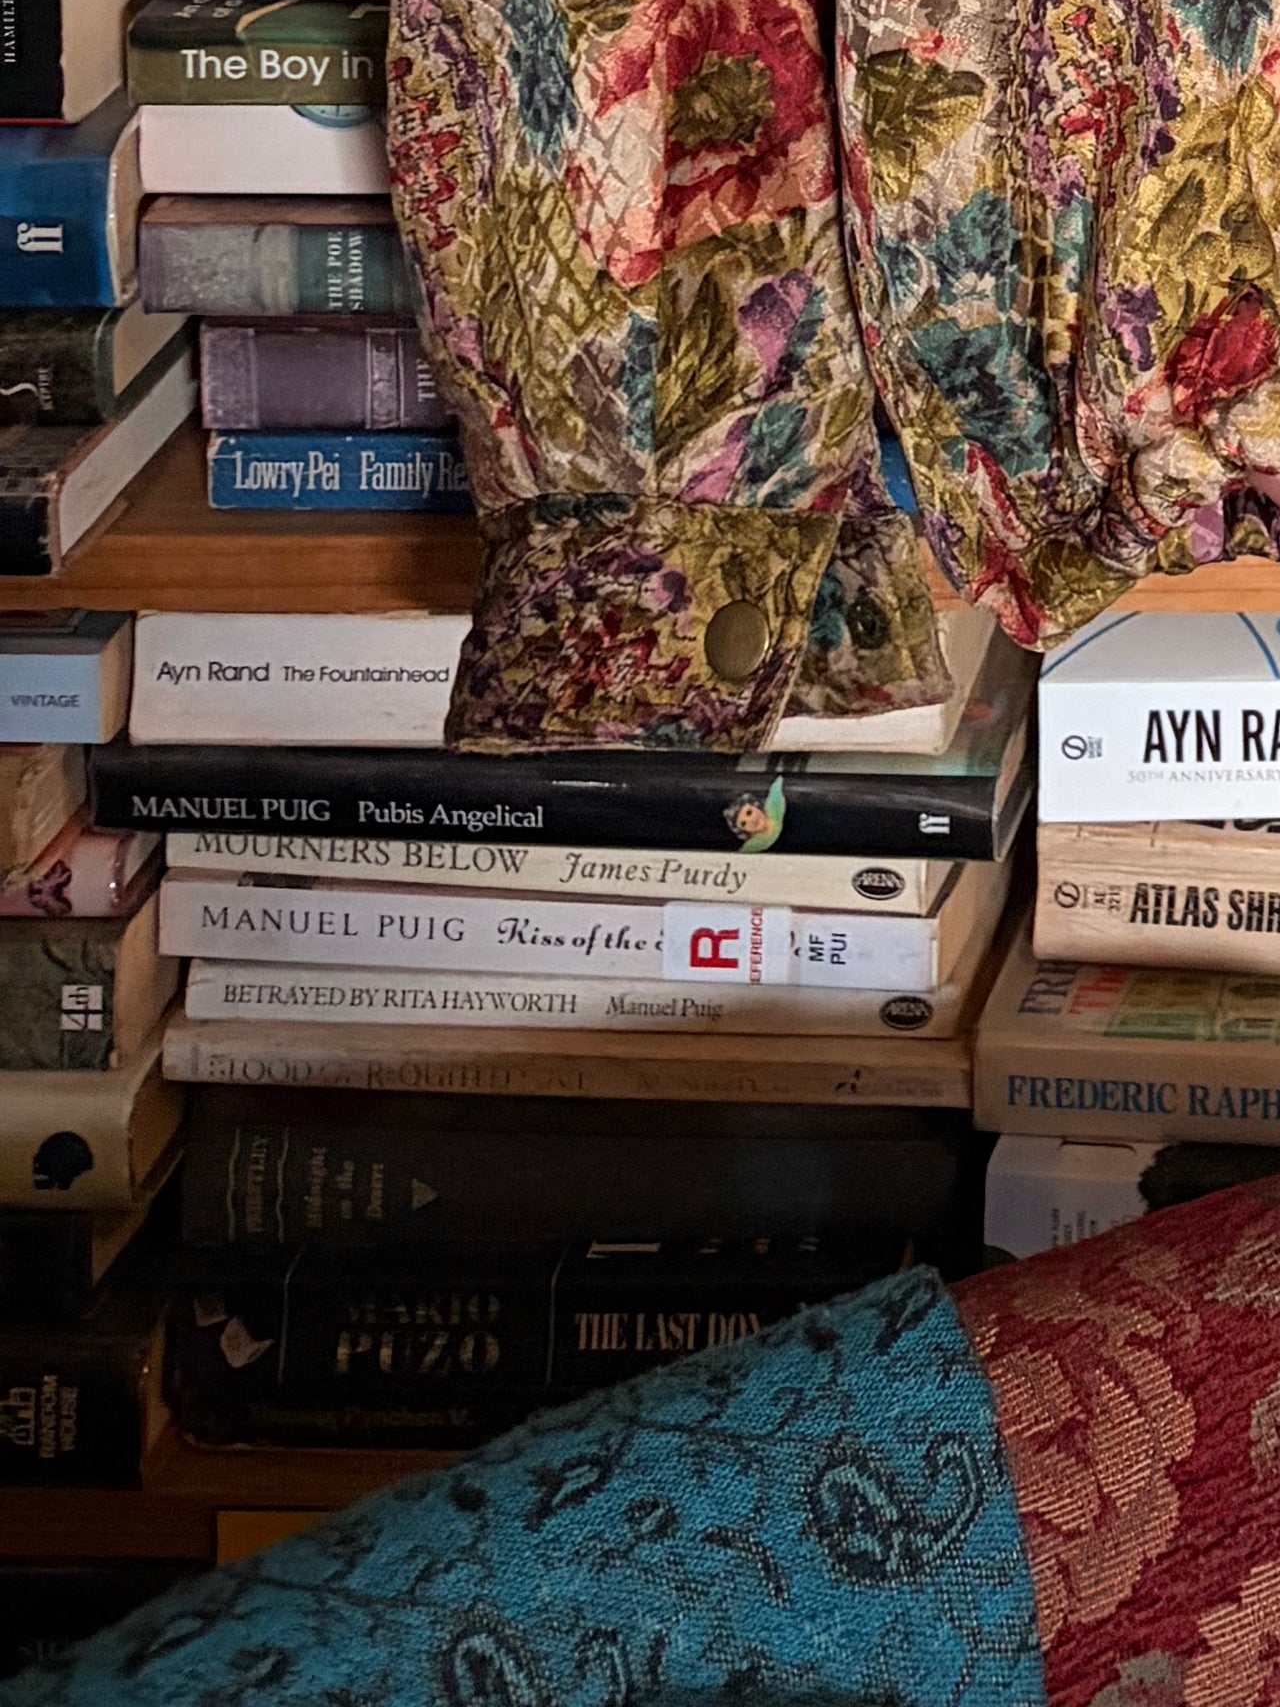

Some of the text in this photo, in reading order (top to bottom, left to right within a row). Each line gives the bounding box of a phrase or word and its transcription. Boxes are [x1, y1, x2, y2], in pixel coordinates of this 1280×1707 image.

[180, 49, 374, 85] The Boy in
[156, 660, 450, 688] Ayn Rand The Fountainhead
[1141, 709, 1221, 764] AYN
[1006, 1073, 1179, 1116] FREDERIC
